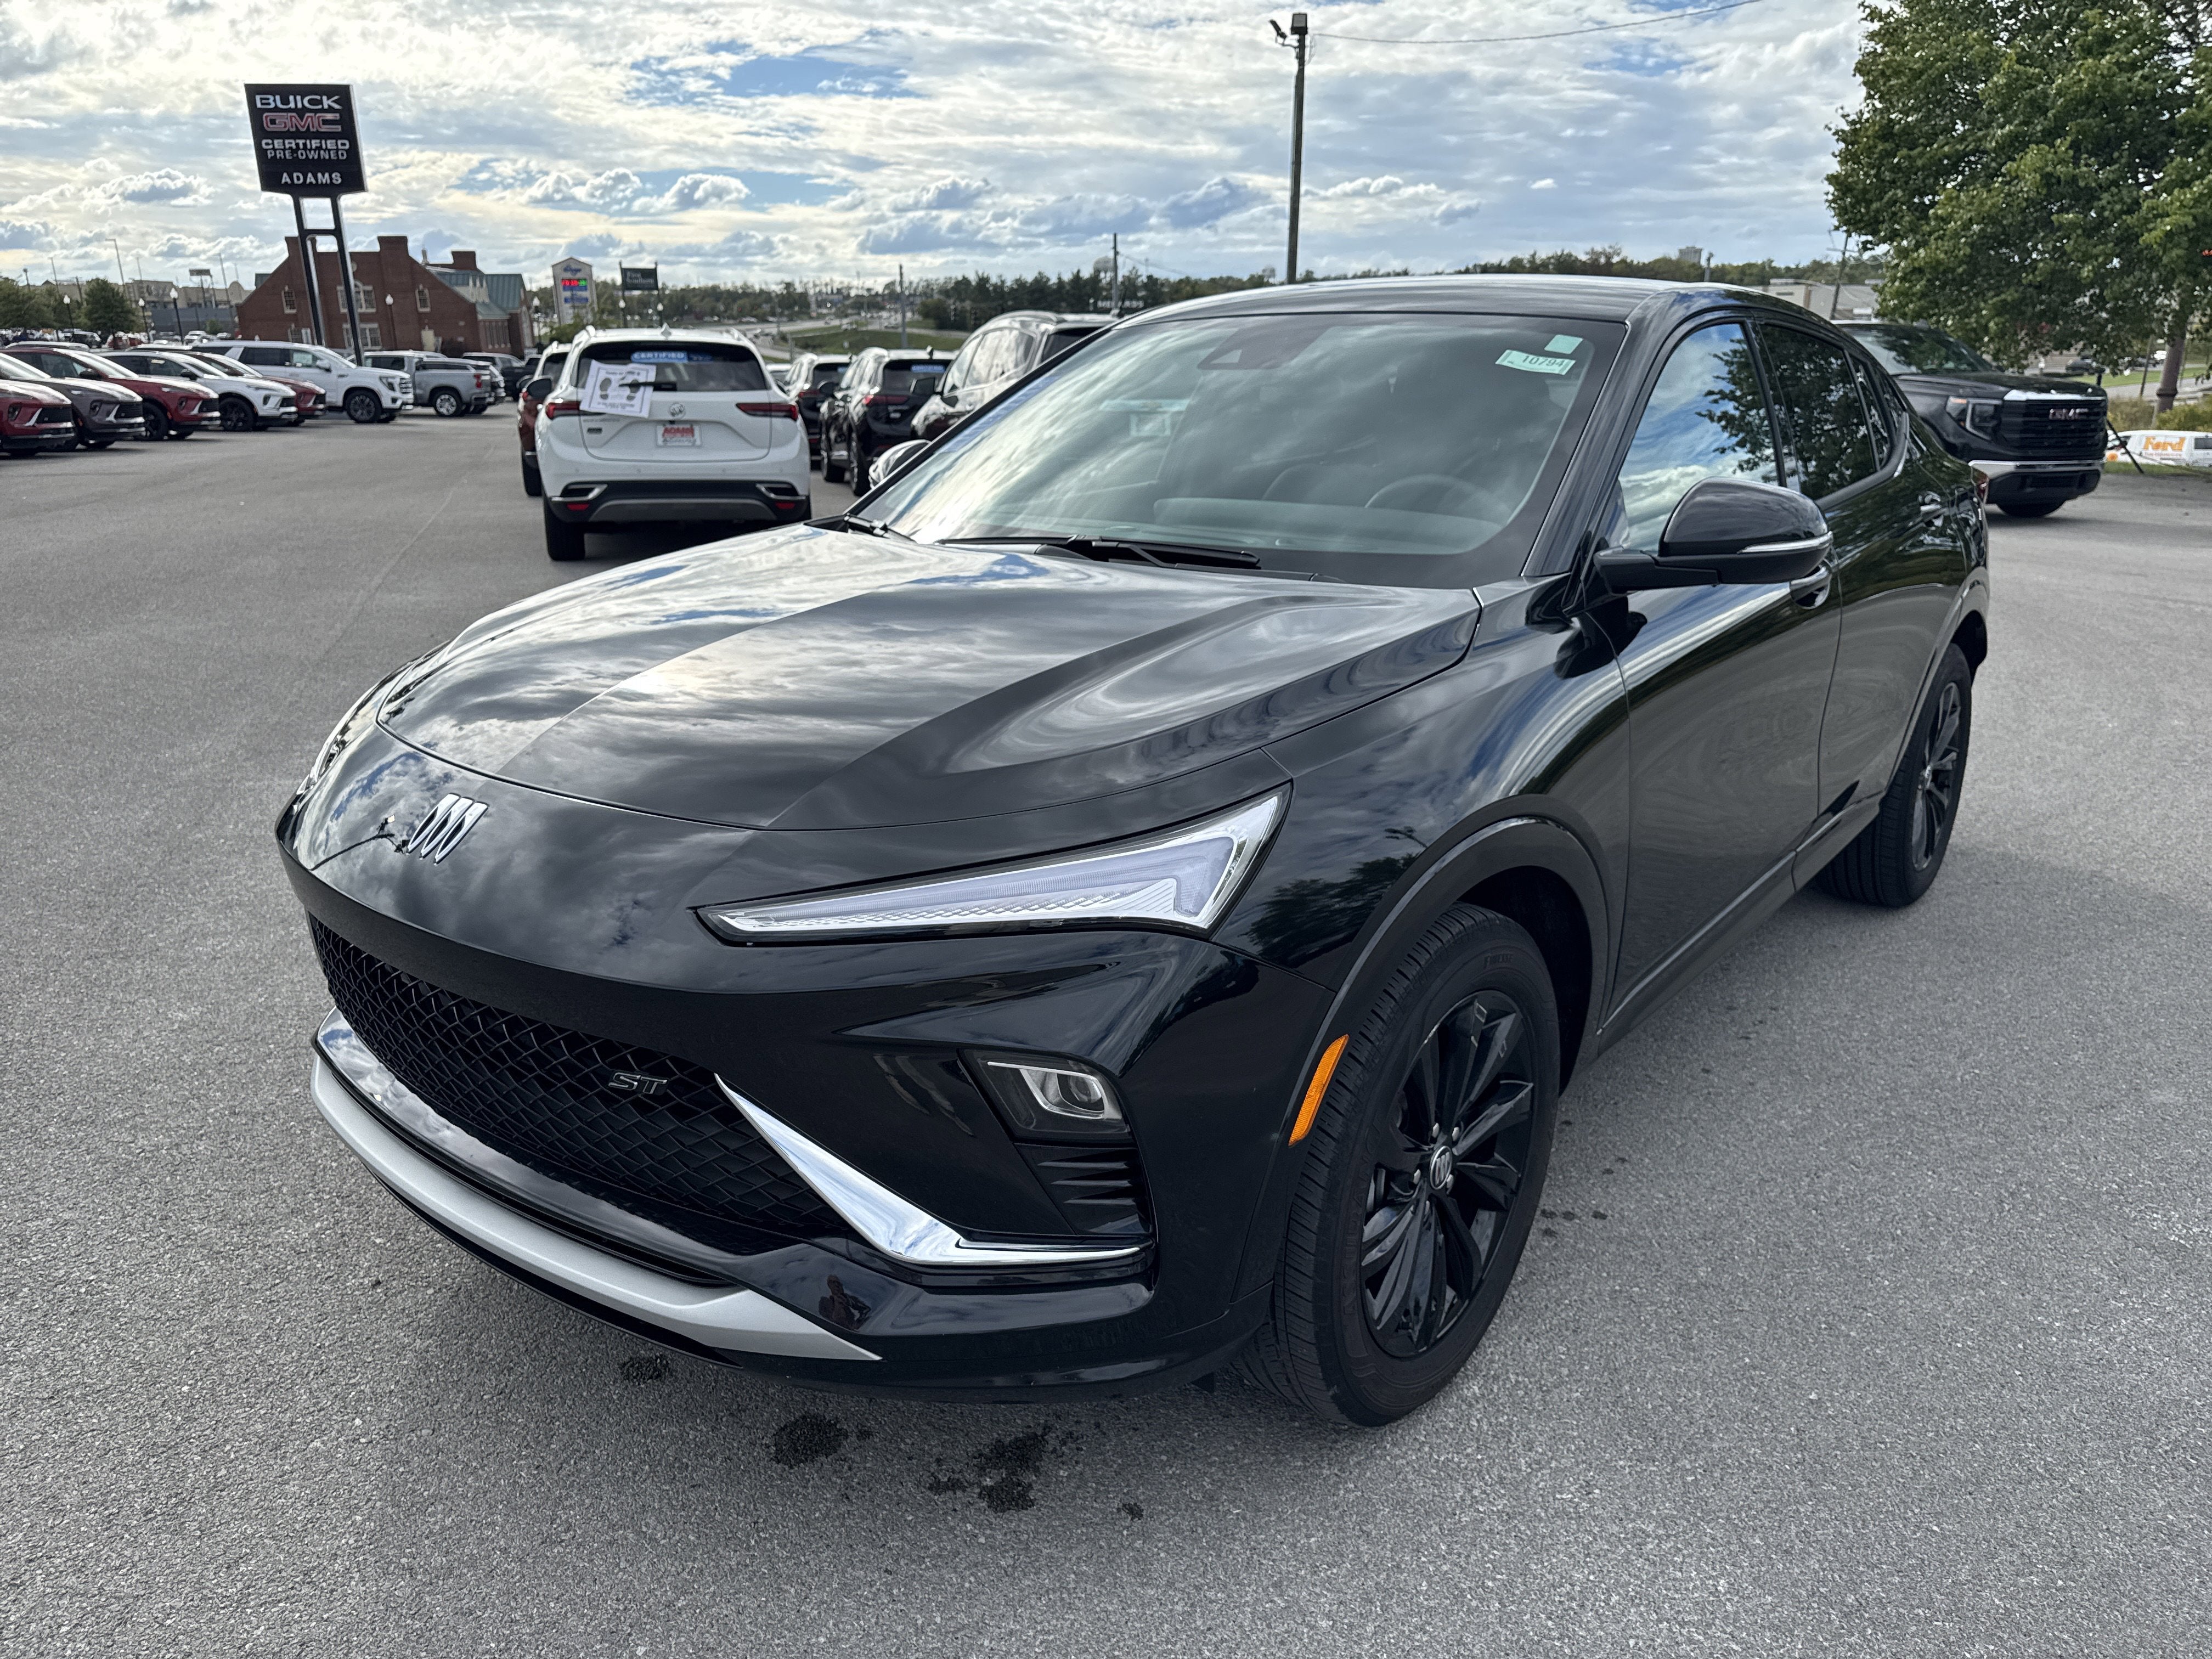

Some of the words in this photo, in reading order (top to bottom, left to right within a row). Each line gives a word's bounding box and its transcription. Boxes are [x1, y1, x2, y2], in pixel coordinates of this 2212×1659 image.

[255, 94, 342, 110] BUICK
[263, 112, 342, 132] GMC
[261, 139, 350, 150] CERTIFIED
[267, 150, 347, 160] PRE-OWNED
[281, 172, 342, 185] ADAMS
[1521, 355, 1565, 368] 10794
[2049, 408, 2089, 420] GMC
[608, 1071, 668, 1094] ST
